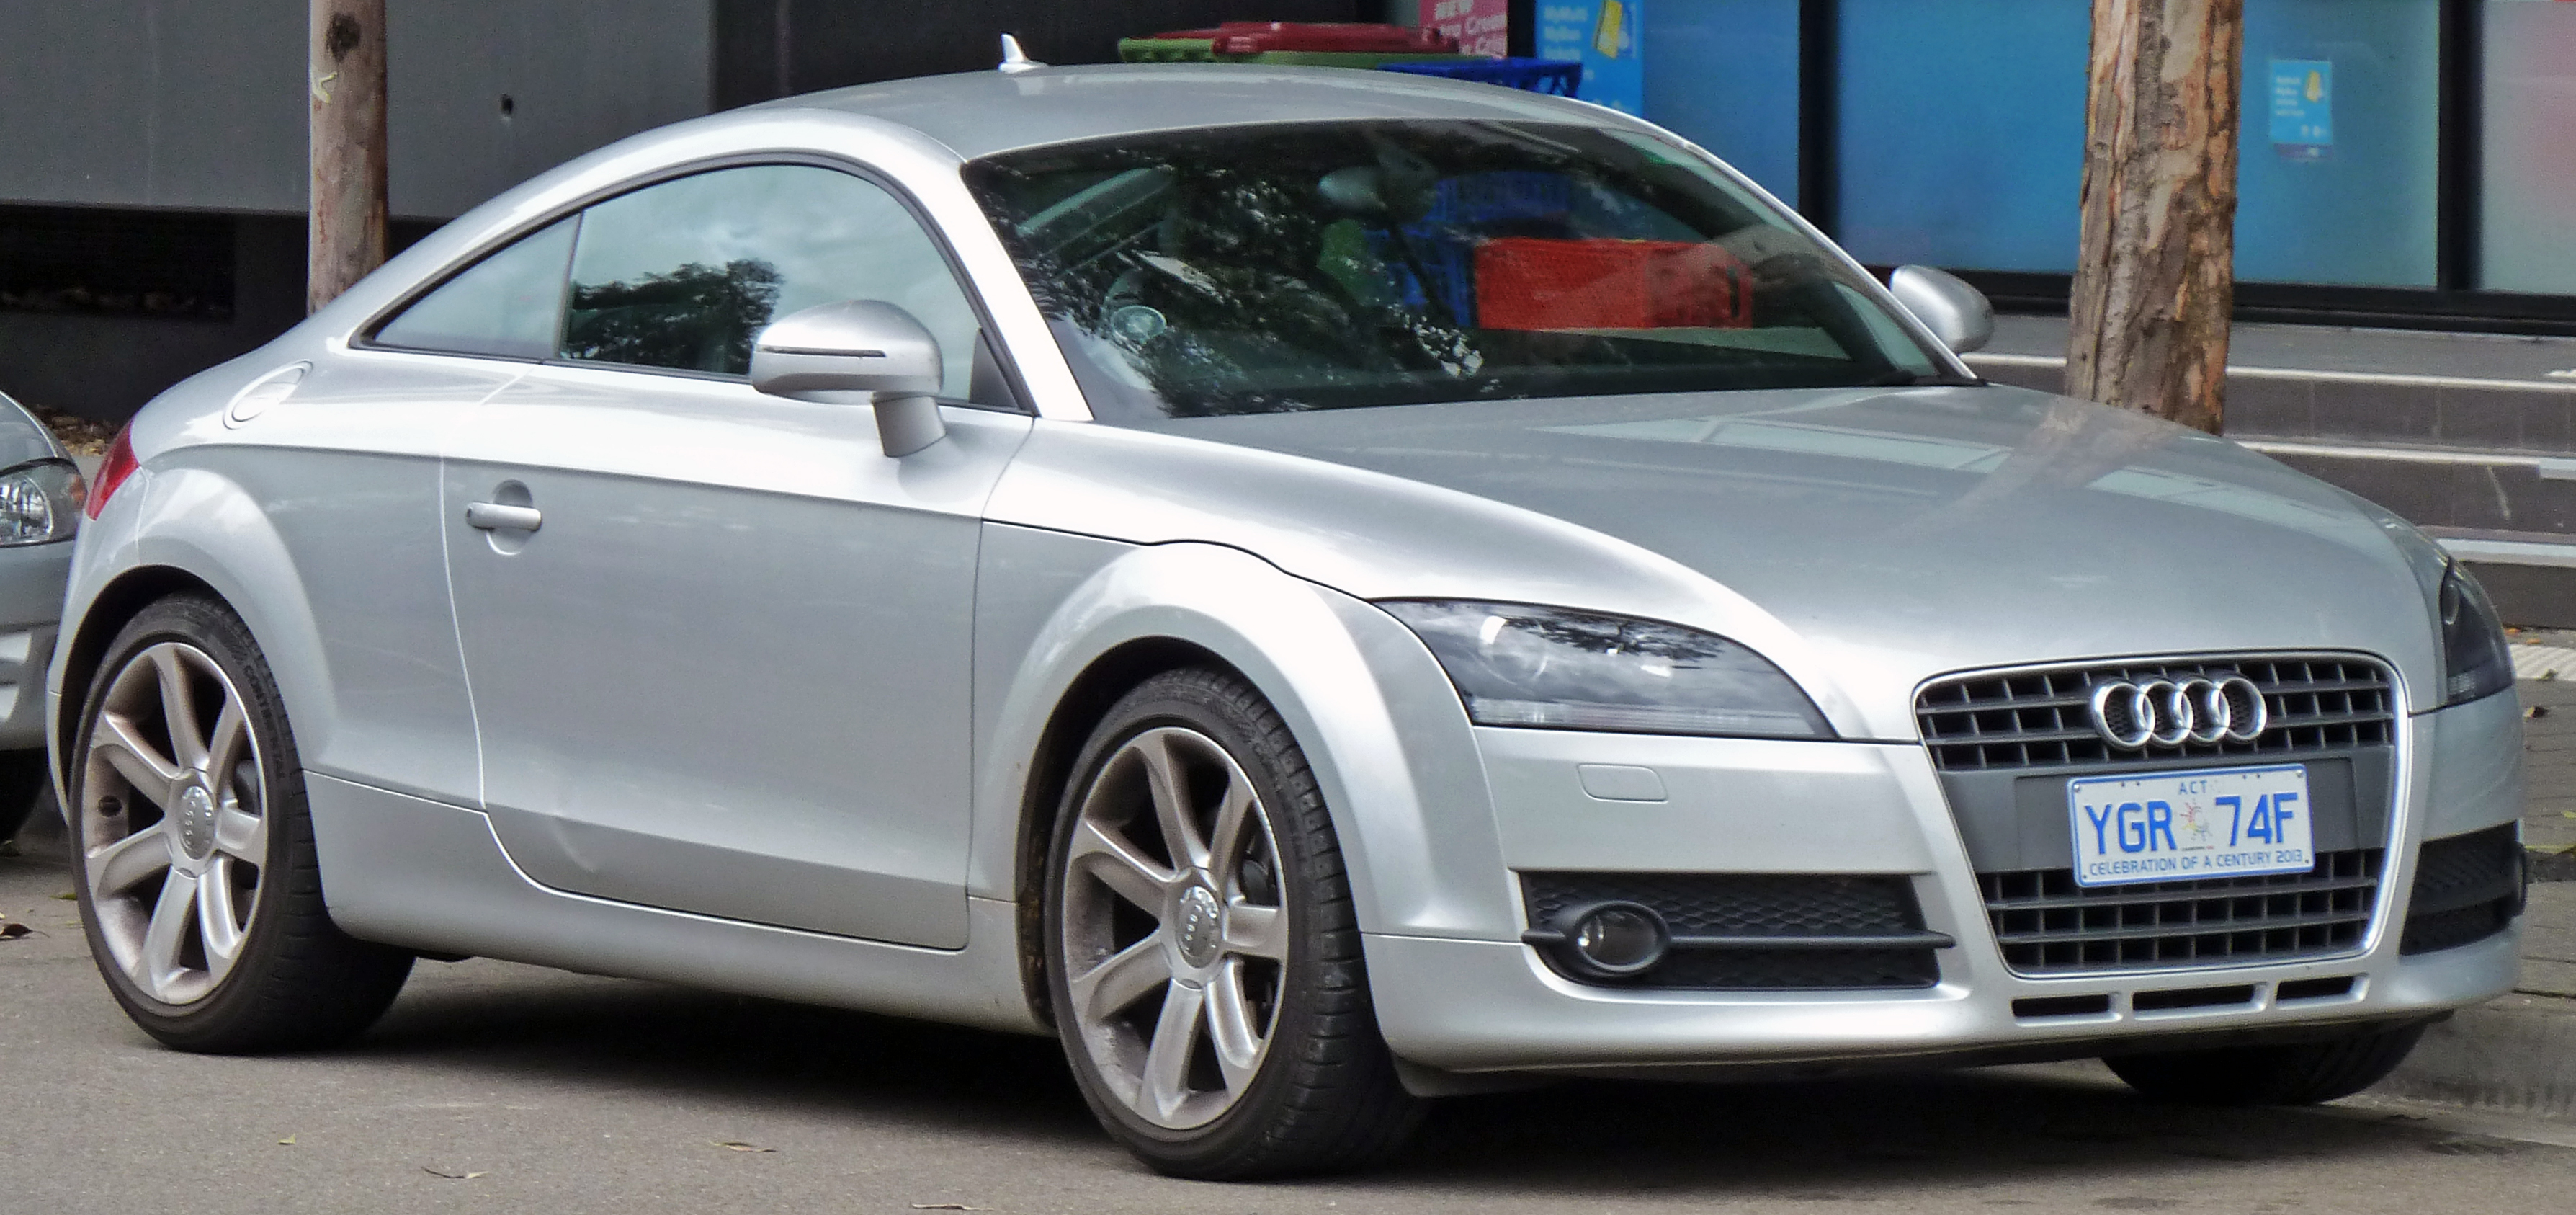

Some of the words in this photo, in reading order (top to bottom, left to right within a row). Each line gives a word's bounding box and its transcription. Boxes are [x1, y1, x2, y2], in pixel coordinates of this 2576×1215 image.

[2178, 780, 2208, 795] ACT
[2084, 800, 2178, 855] YGR
[2215, 792, 2299, 847] 74F
[2090, 857, 2177, 876] CELEBRATION
[2181, 855, 2199, 871] OF
[2204, 855, 2213, 868] A
[2217, 851, 2271, 868] CENTURY
[2276, 849, 2303, 863] 2013
